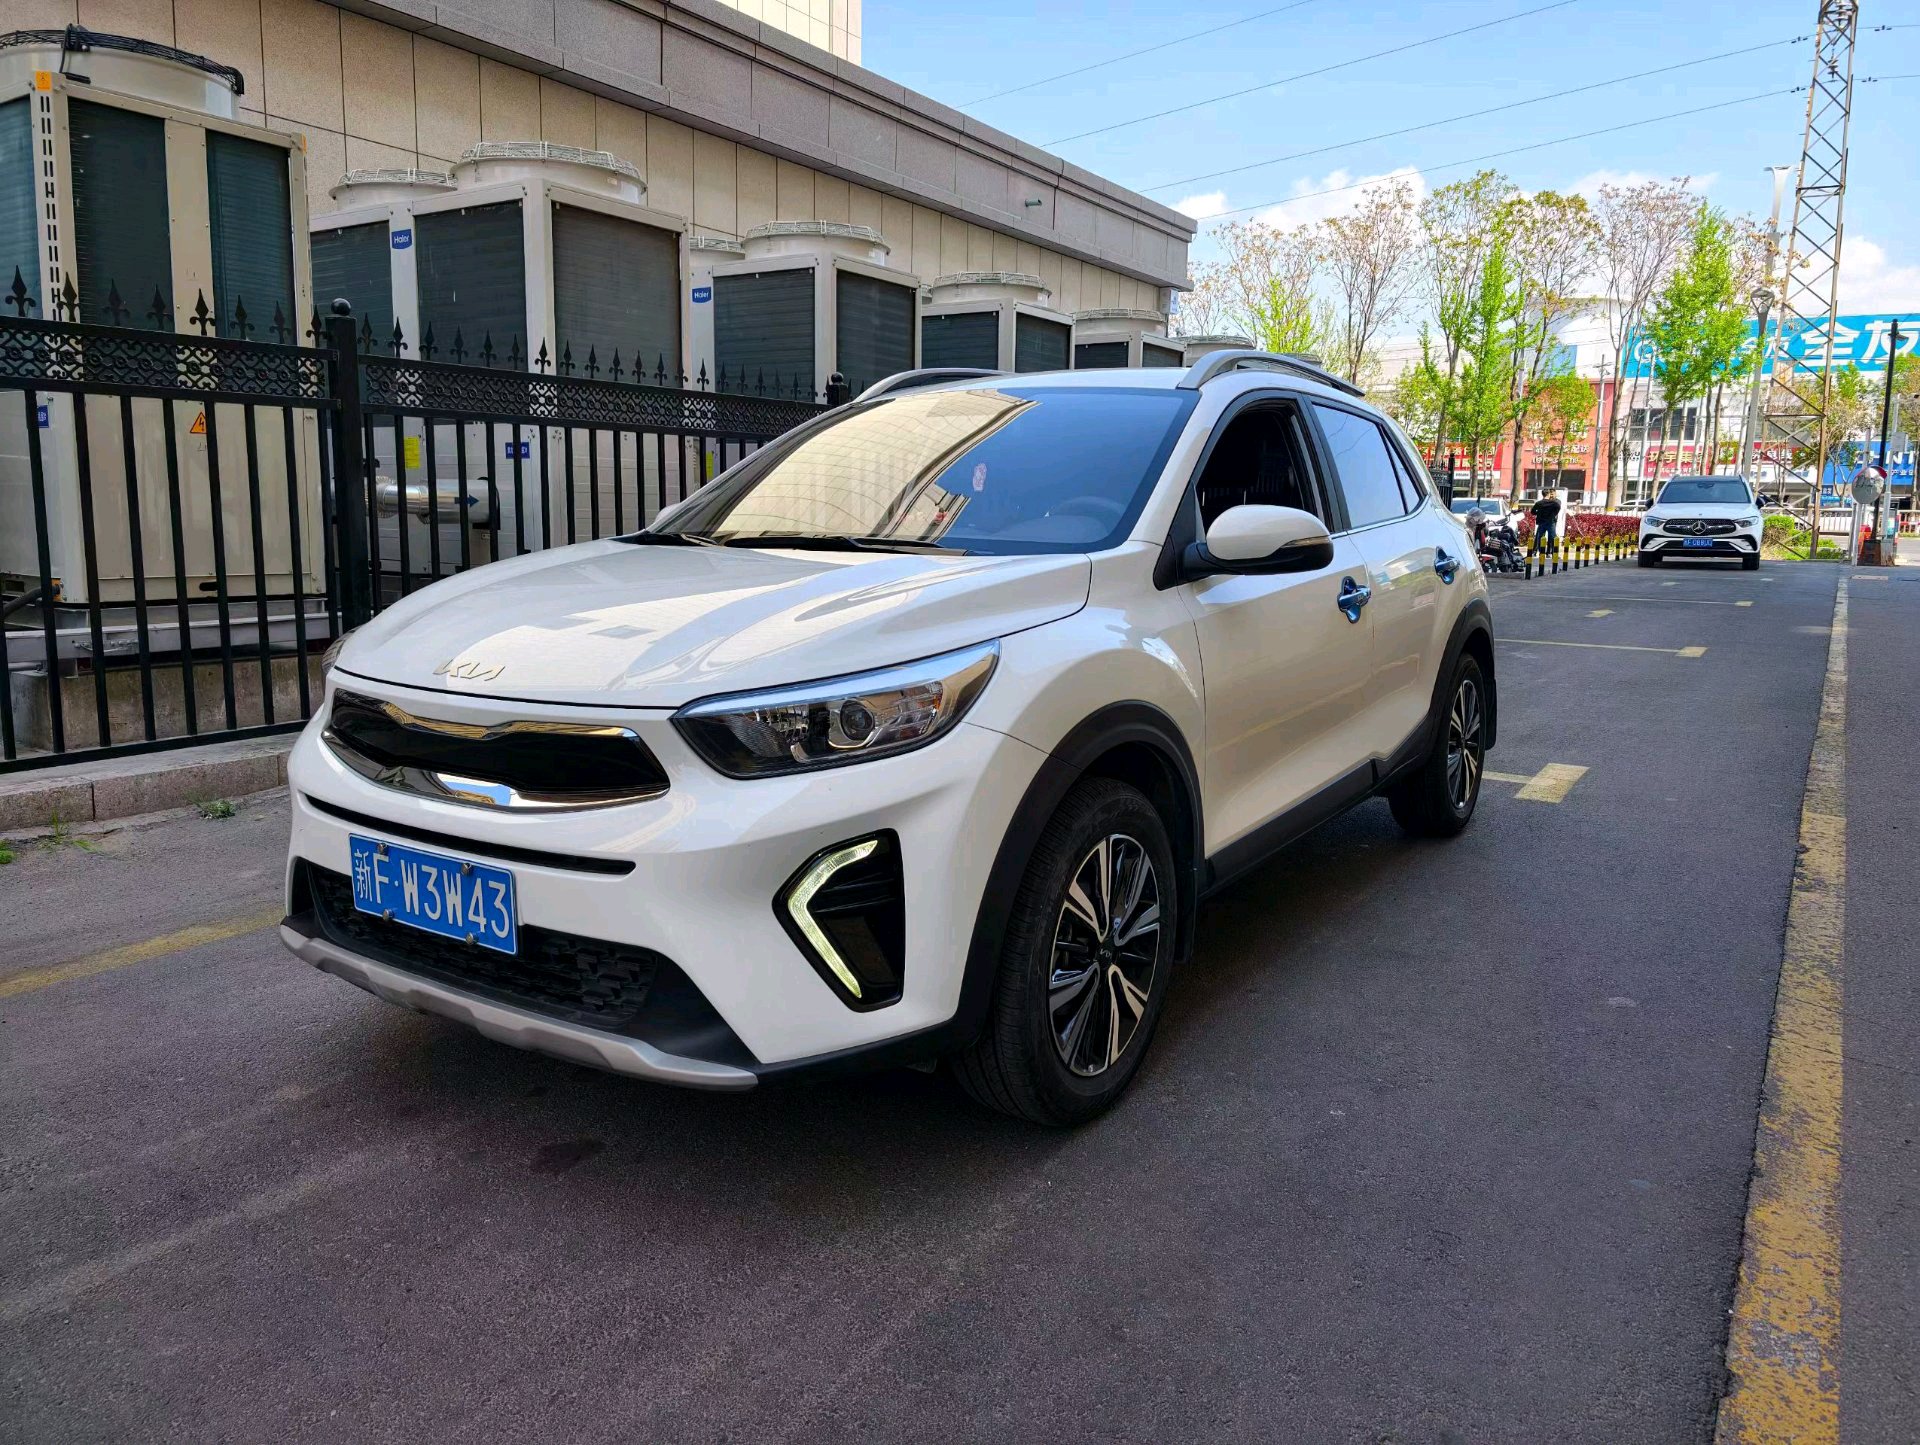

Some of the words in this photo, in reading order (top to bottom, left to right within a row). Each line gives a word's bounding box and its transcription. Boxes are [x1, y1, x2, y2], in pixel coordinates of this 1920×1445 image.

[393, 234, 410, 244] Haier
[694, 290, 709, 299] Haier
[1799, 320, 1920, 367] 全友
[432, 658, 506, 681] KIA
